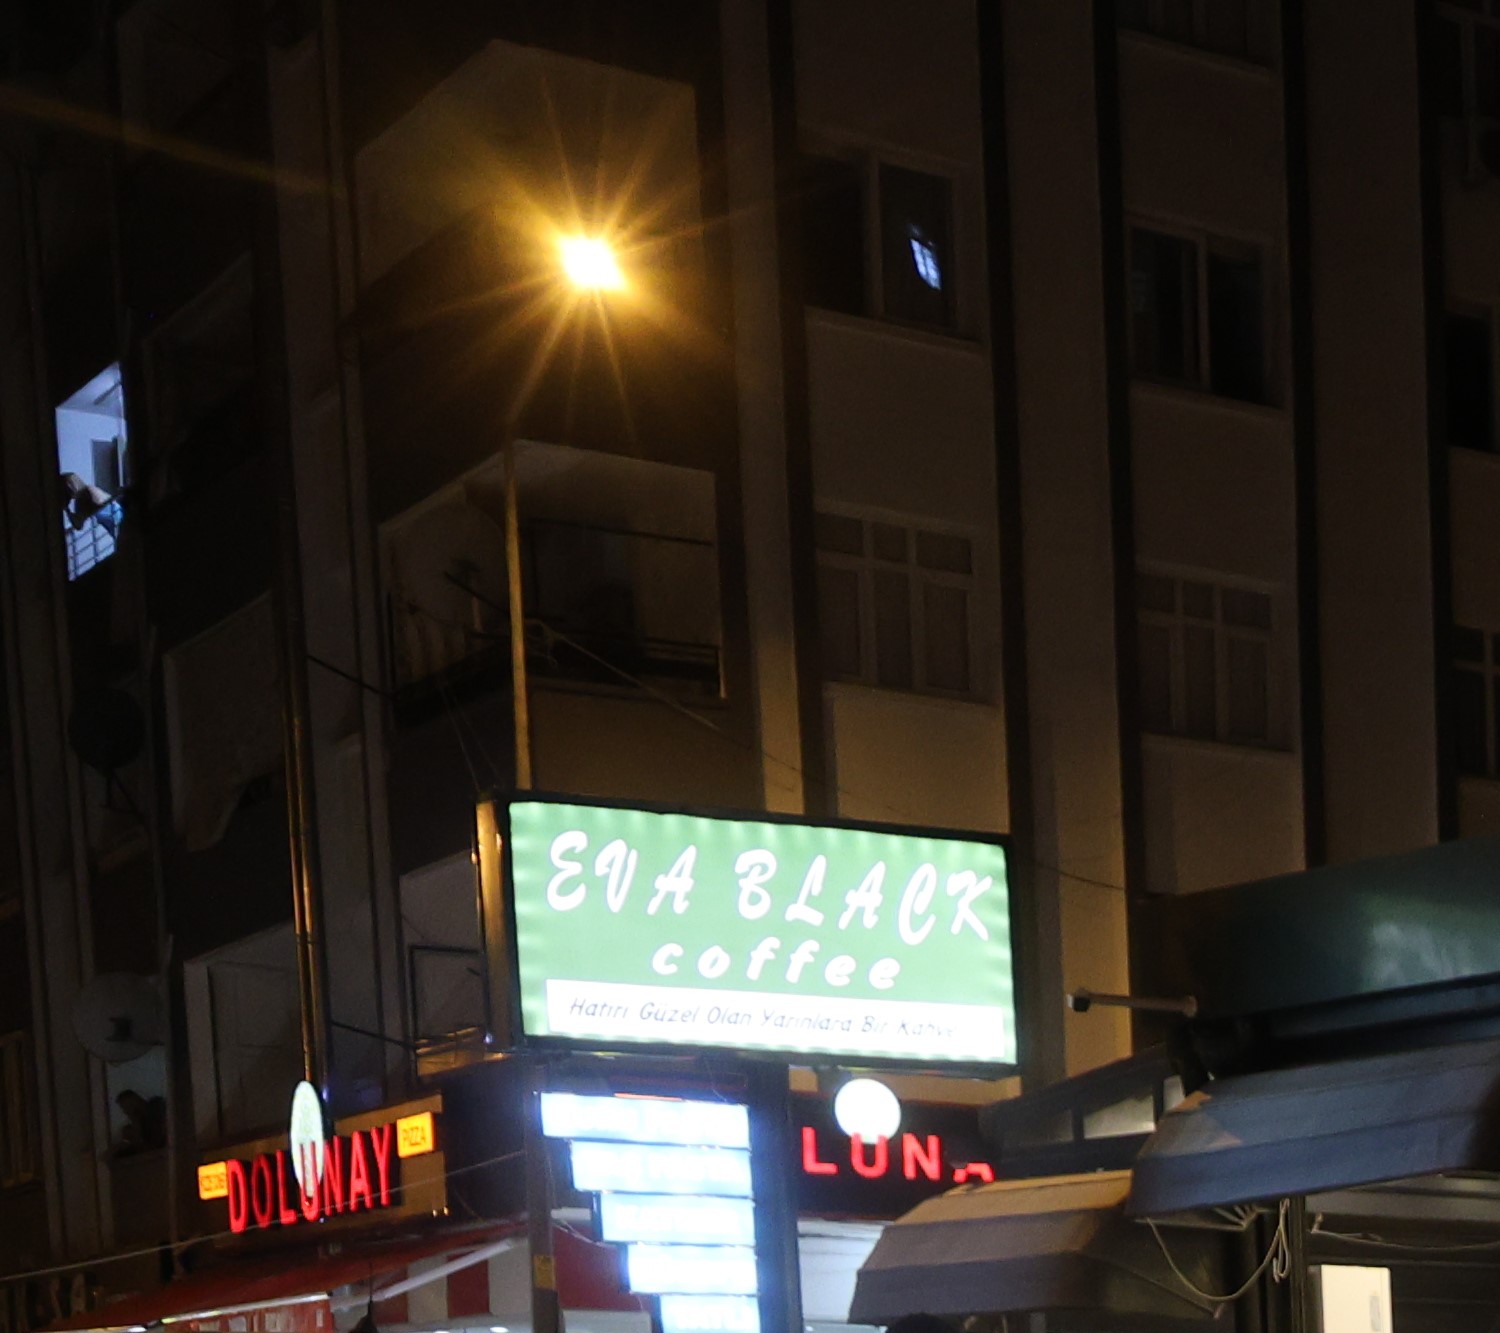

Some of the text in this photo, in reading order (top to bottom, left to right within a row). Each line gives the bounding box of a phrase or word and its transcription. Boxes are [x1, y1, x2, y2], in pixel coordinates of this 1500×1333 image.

[546, 829, 995, 948] EVA BLACK
[652, 936, 902, 993] coffee
[638, 1000, 700, 1025] Güzel
[707, 1005, 753, 1028] Olan
[402, 1125, 427, 1148] PIZZA
[226, 1123, 394, 1235] DOLUNAY
